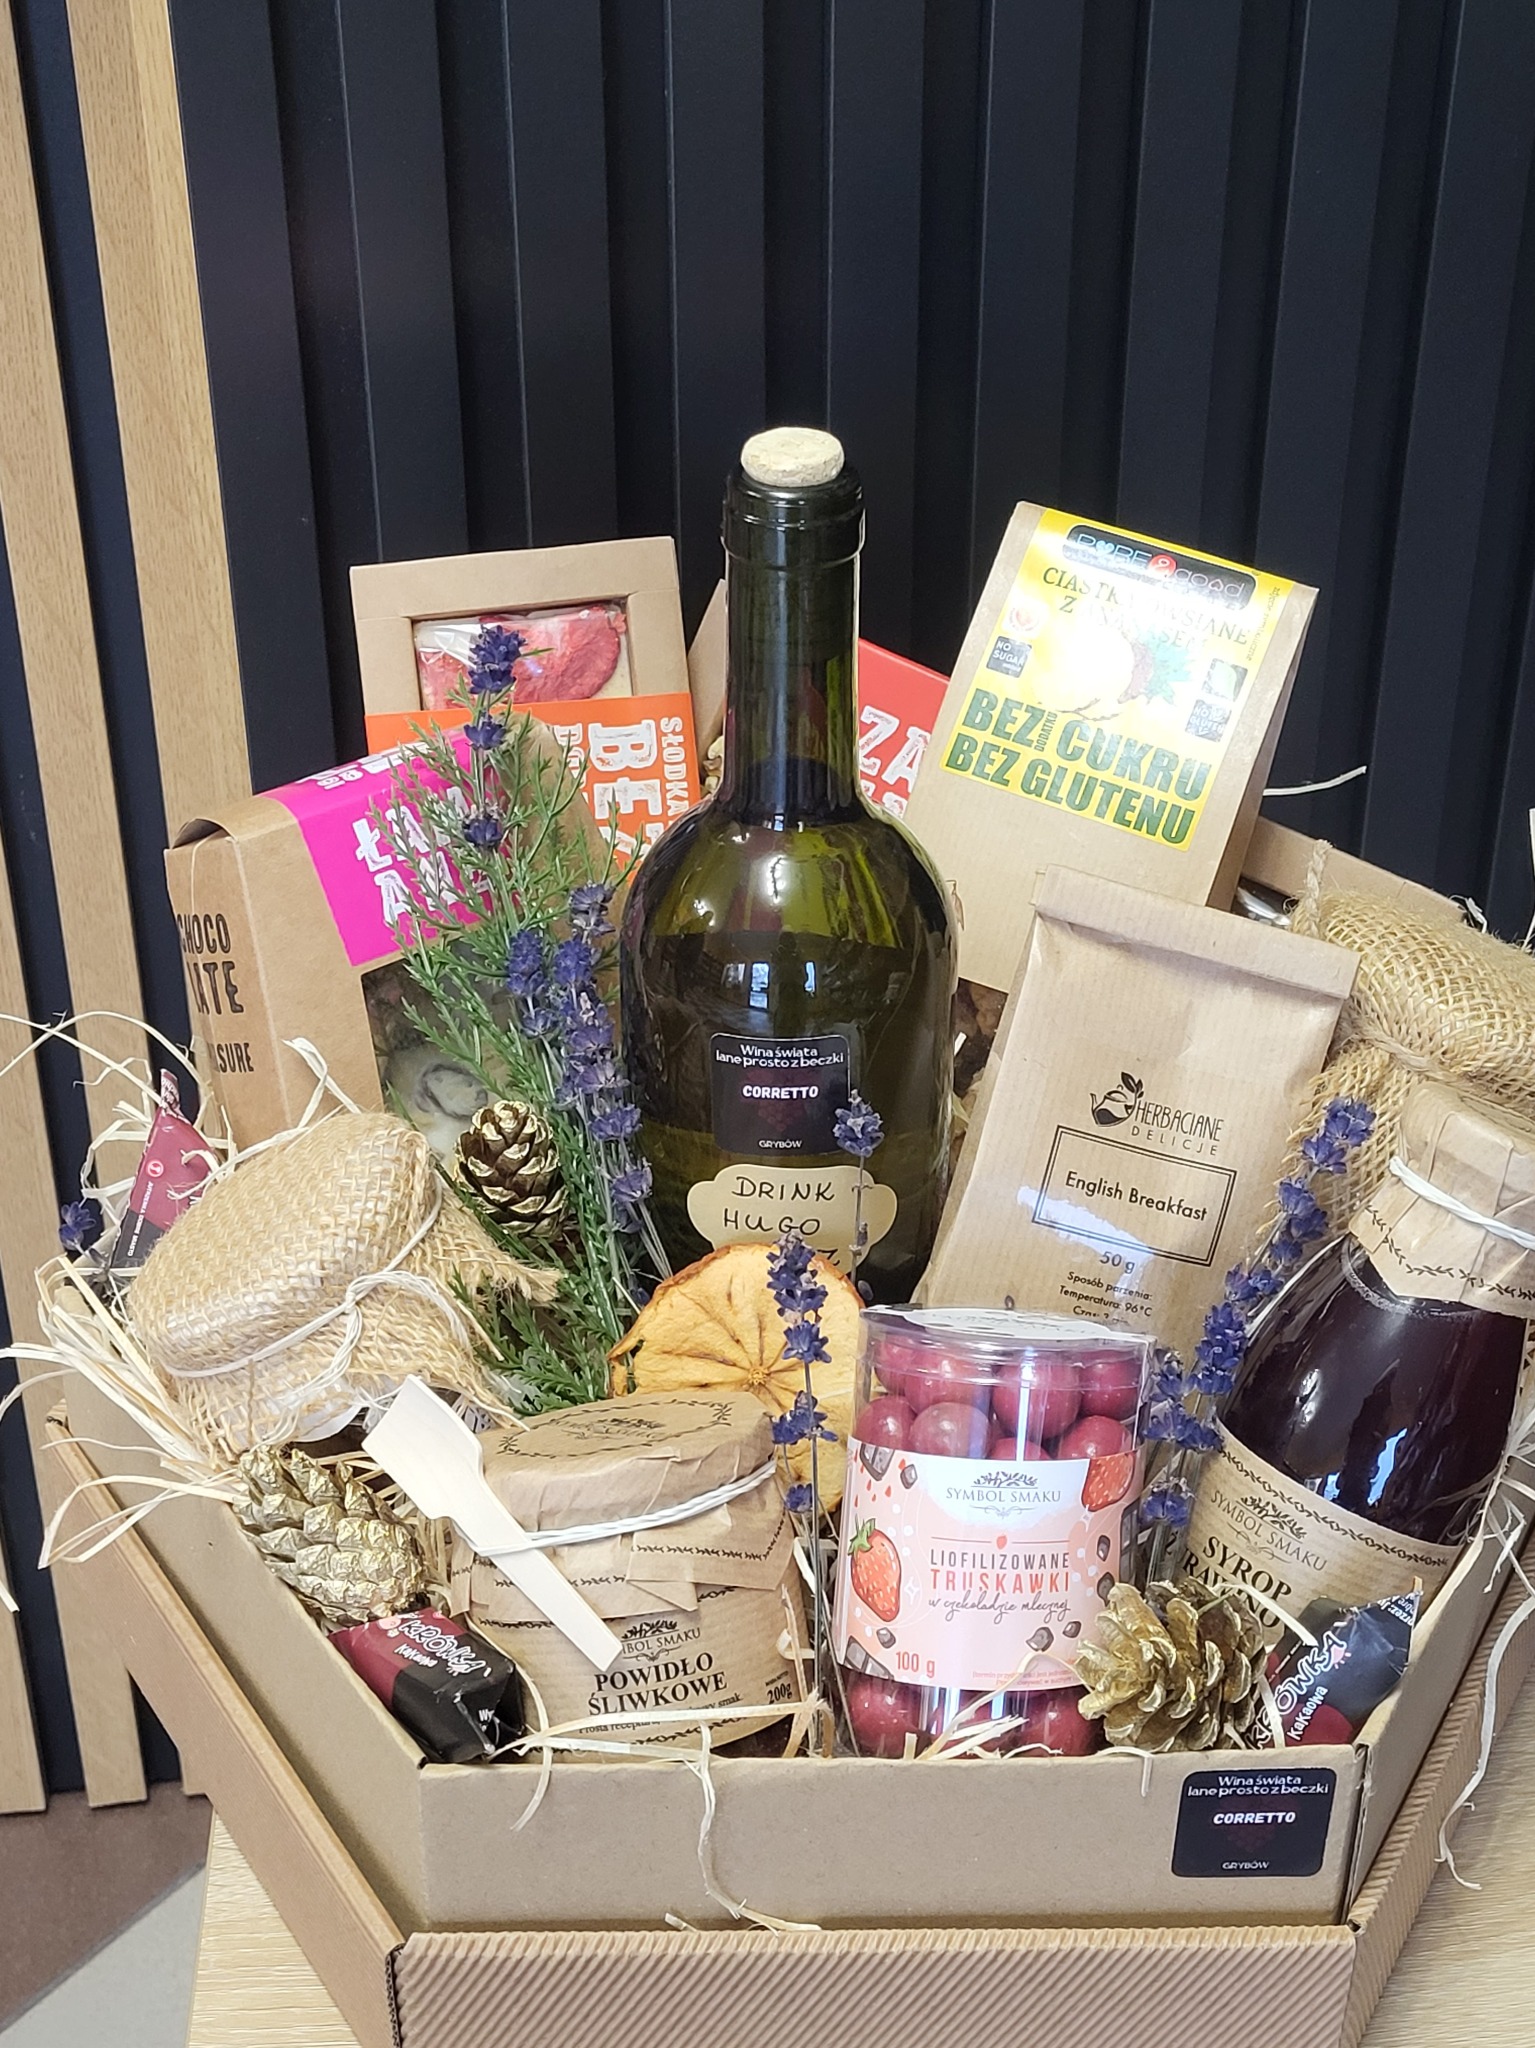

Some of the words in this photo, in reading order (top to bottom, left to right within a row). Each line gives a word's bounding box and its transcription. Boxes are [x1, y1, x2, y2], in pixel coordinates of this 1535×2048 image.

[1043, 567, 1135, 605] CIASTK
[1058, 595, 1078, 614] Z
[996, 641, 1012, 652] NO
[962, 688, 1045, 748] BEZ
[1056, 720, 1212, 801] CUKRU
[945, 732, 1021, 787] BEZ
[1020, 758, 1195, 844] GLUTENU
[214, 1042, 254, 1074] SURE
[716, 1050, 741, 1065] lane
[743, 1057, 790, 1068] prosto
[790, 1058, 799, 1068] z
[800, 1053, 844, 1067] beczki
[740, 1044, 774, 1057] Wina
[776, 1045, 818, 1058] świata
[742, 1085, 819, 1099] CORRETTO
[1135, 1100, 1224, 1142] HERBACIANE
[758, 1139, 803, 1149] GRYBÓW
[1131, 1125, 1218, 1156] DELICJE
[732, 1176, 835, 1201] DRINK
[1065, 1170, 1123, 1200] English
[1129, 1188, 1207, 1222] Breakfast
[723, 1208, 820, 1236] HUGO
[1099, 1250, 1122, 1268] 50
[1125, 1260, 1137, 1275] g
[1067, 1271, 1104, 1289] Sposób
[1125, 1302, 1153, 1317] 96°C
[946, 1487, 1005, 1502] SYMBOL
[1010, 1490, 1061, 1502] SMAKU
[1211, 1490, 1262, 1538] SYMBOL
[1266, 1531, 1328, 1571] SMAKU
[930, 1549, 1070, 1571] LIOFILIZOWANE
[1202, 1536, 1292, 1601] SYROP
[930, 1569, 1070, 1594] TRUSKAWKI
[928, 1598, 941, 1607] w
[943, 1589, 1018, 1625] czekoladzie
[1021, 1590, 1072, 1625] mlecznej
[622, 1640, 653, 1654] BOL
[656, 1627, 701, 1648] SMAKU
[594, 1652, 713, 1692] POWIDŁO
[895, 1651, 920, 1672] 100
[926, 1659, 935, 1677] g
[588, 1671, 727, 1716] ŚLIWKOWE
[767, 1682, 792, 1704] 200g
[1187, 1786, 1217, 1797] lane
[1218, 1786, 1270, 1798] prosto
[1270, 1787, 1280, 1795] z
[1281, 1782, 1329, 1794] beczki
[1218, 1776, 1254, 1786] Wina
[1255, 1774, 1302, 1785] świata
[1213, 1812, 1296, 1825] CORRETTO
[1222, 1861, 1270, 1871] GRYBÓW
